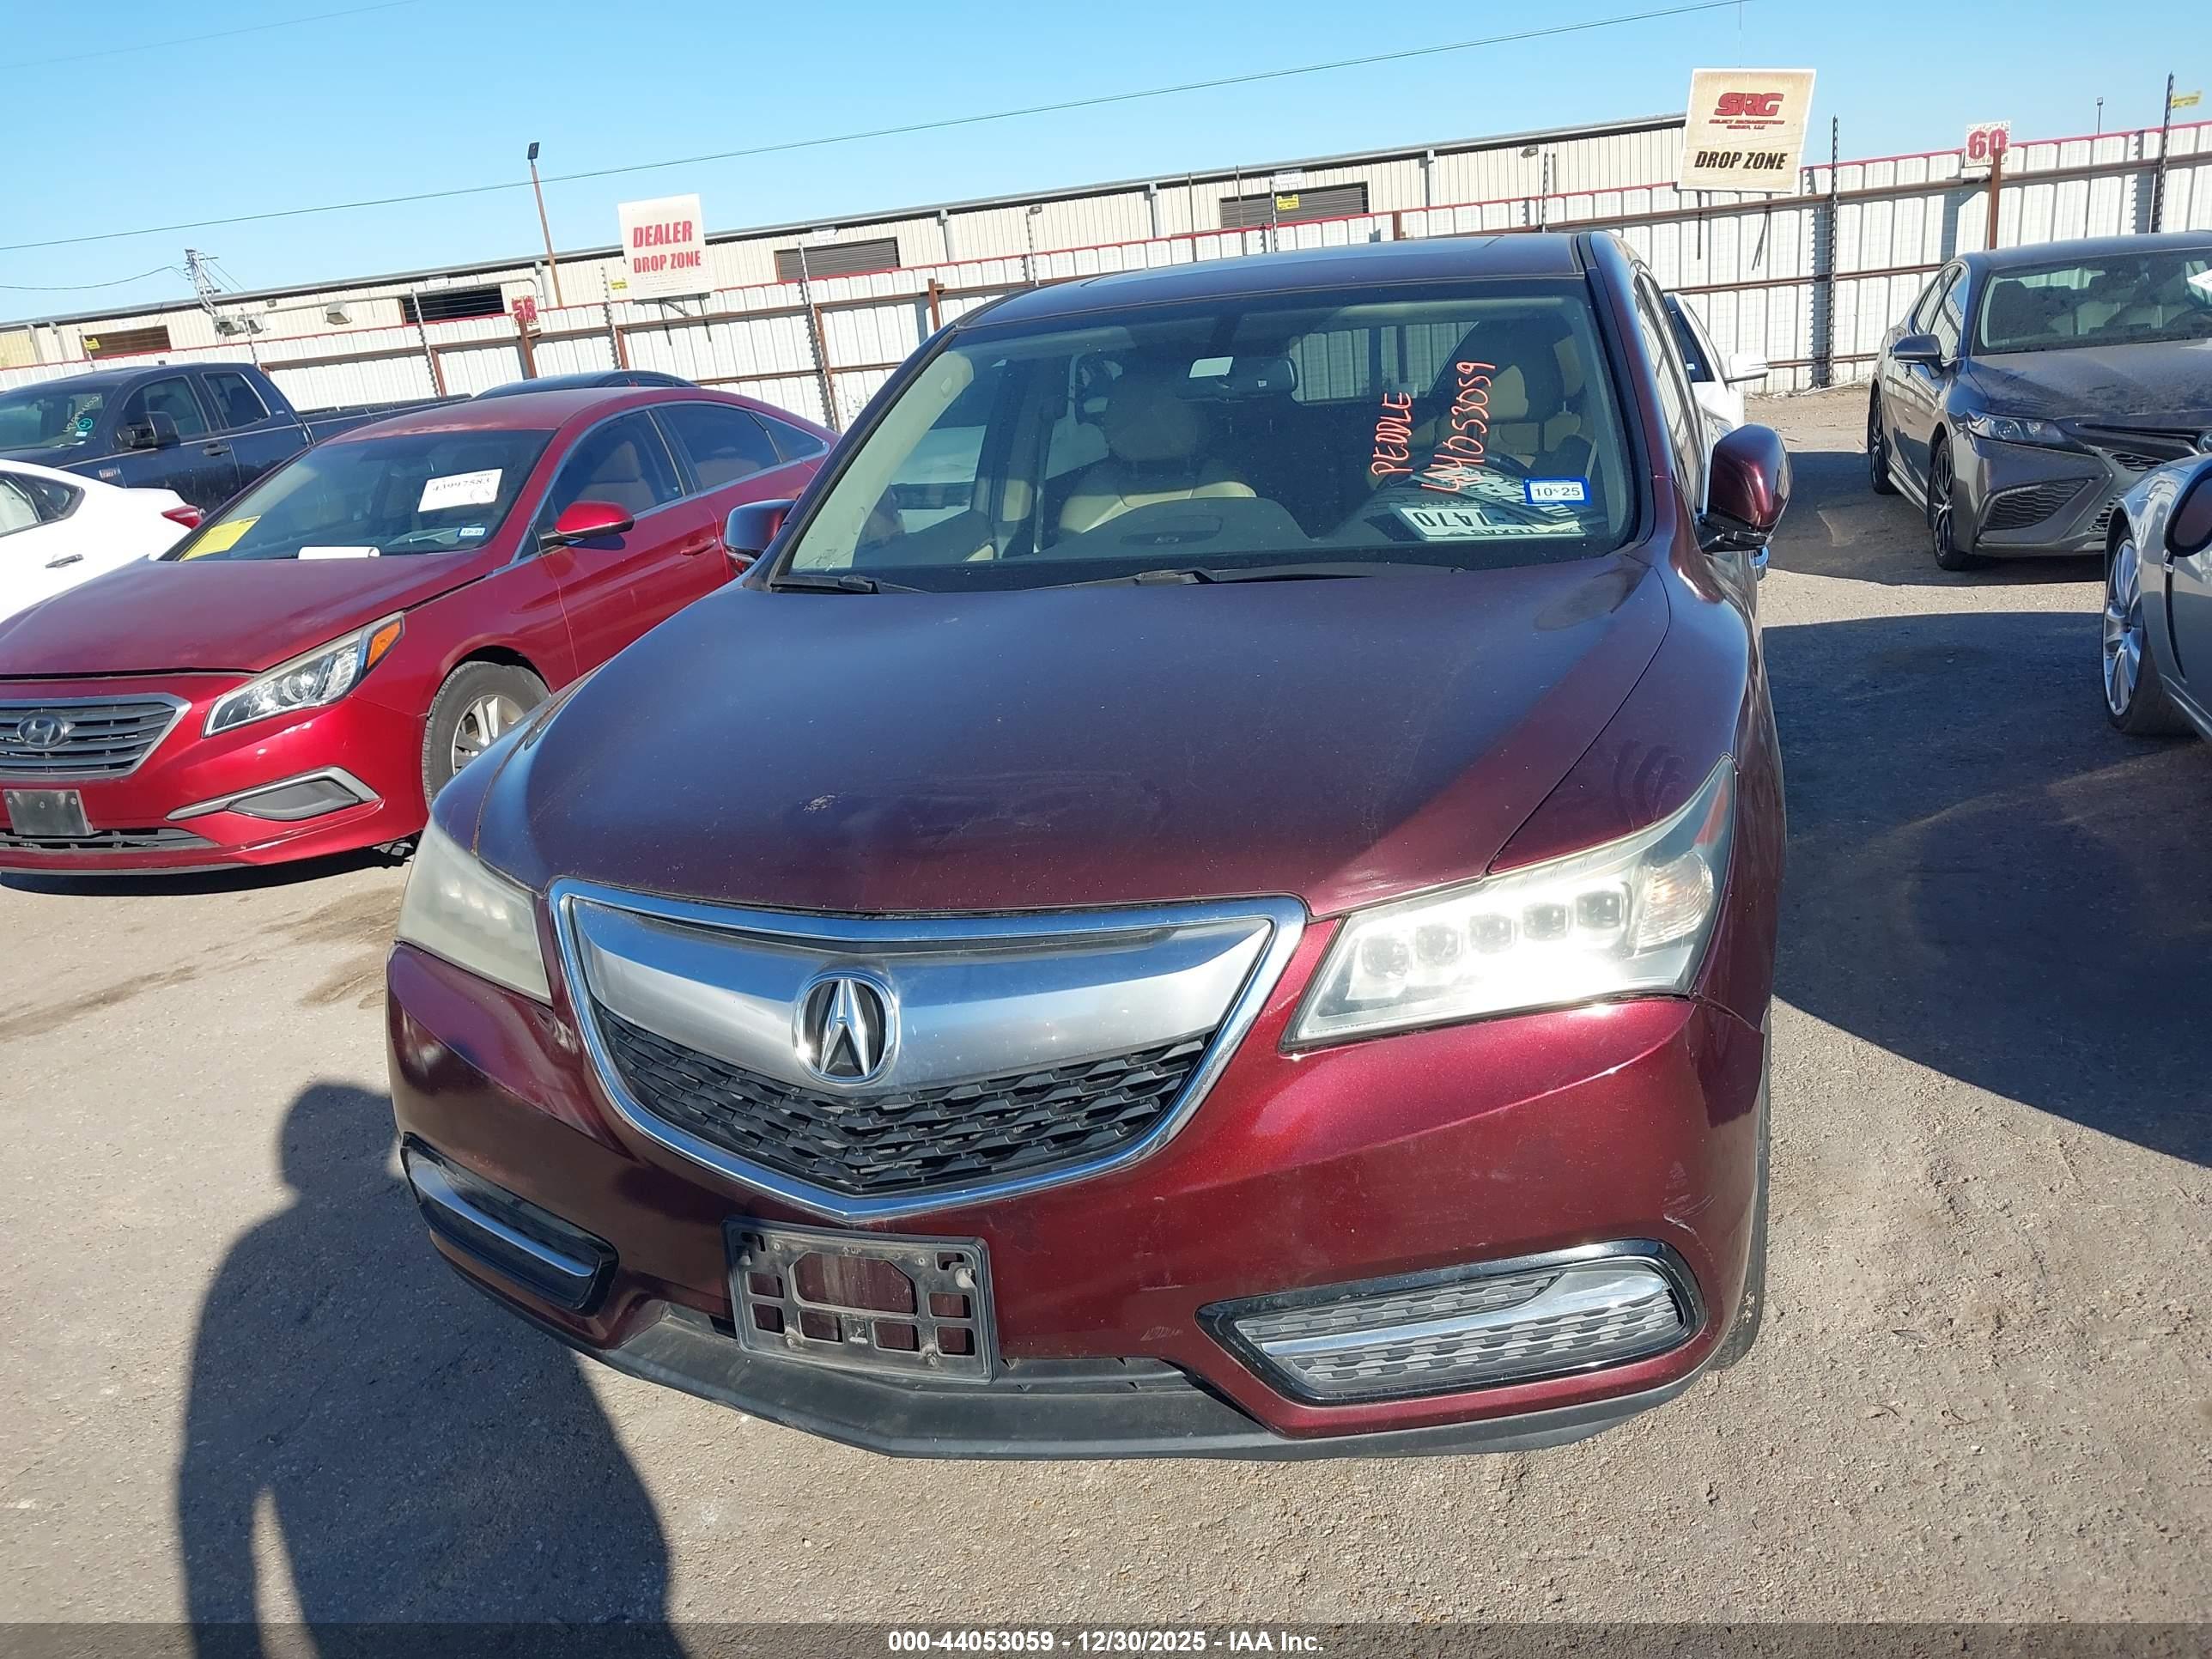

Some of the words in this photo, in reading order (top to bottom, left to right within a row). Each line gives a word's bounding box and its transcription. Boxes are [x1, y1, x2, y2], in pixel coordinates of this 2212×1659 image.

[1714, 93, 1784, 116] SRG
[1968, 129, 2007, 160] 60
[1694, 151, 1742, 168] DROP
[1743, 152, 1788, 170] ZONE
[633, 221, 693, 248] DEALER
[634, 254, 666, 273] DROP
[670, 250, 702, 270] ZONE
[1370, 392, 1413, 476] PEDDLE
[1420, 361, 1498, 493] 44053059
